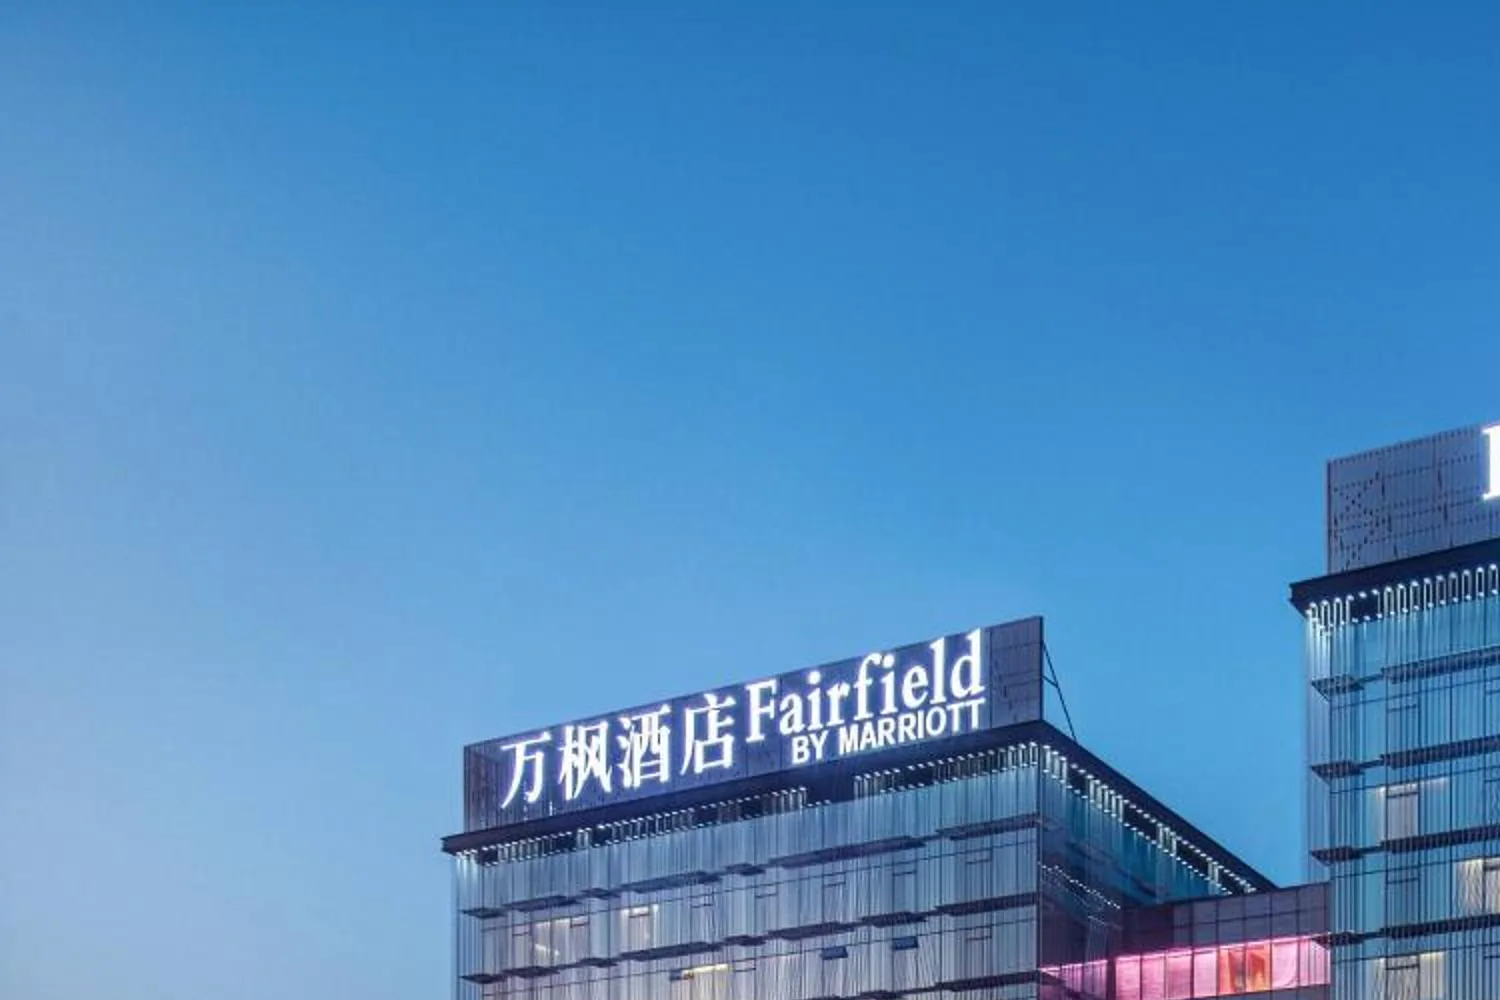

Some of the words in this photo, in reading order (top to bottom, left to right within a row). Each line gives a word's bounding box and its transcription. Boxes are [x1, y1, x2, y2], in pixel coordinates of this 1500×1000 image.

[744, 627, 986, 743] Fairfield
[791, 733, 827, 765] BY
[838, 698, 986, 754] MARRIOTT
[500, 693, 737, 808] 万枫酒店
